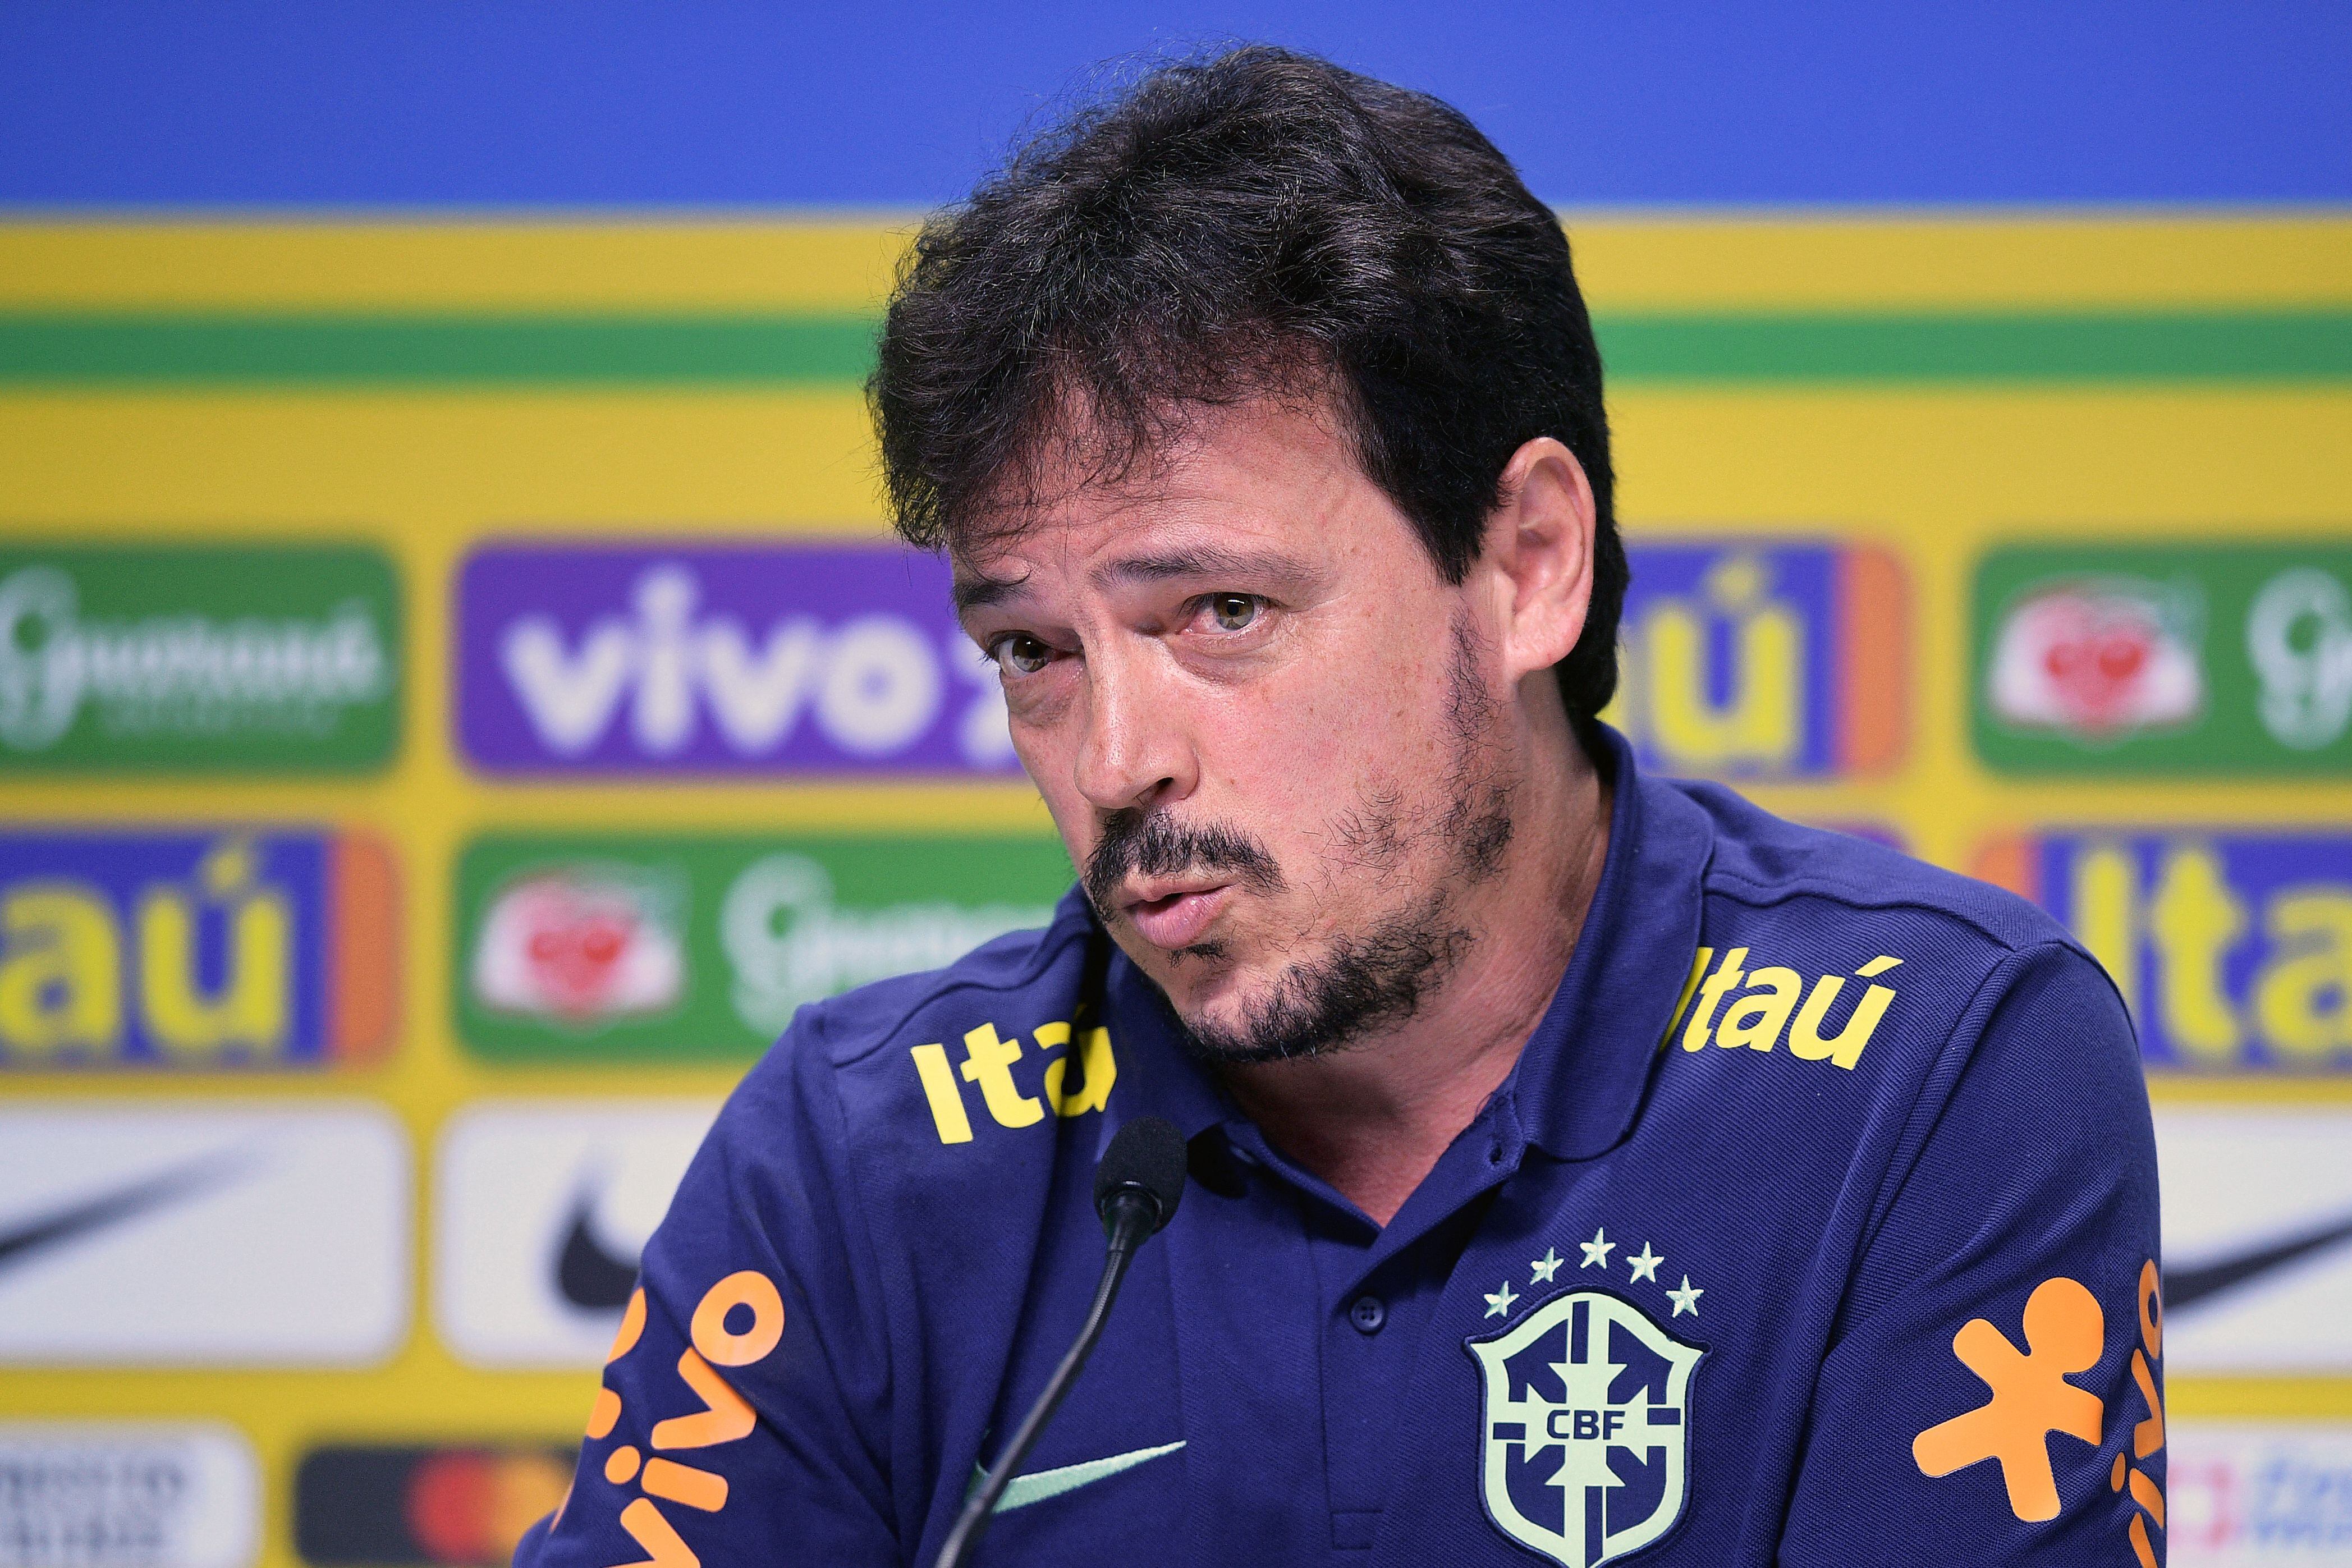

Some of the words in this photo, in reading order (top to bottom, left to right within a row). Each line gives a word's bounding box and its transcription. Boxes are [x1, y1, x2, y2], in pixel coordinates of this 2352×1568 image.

[498, 564, 944, 759] vivo
[1659, 946, 1904, 1071] Itaú
[1546, 1409, 1626, 1441] CBF
